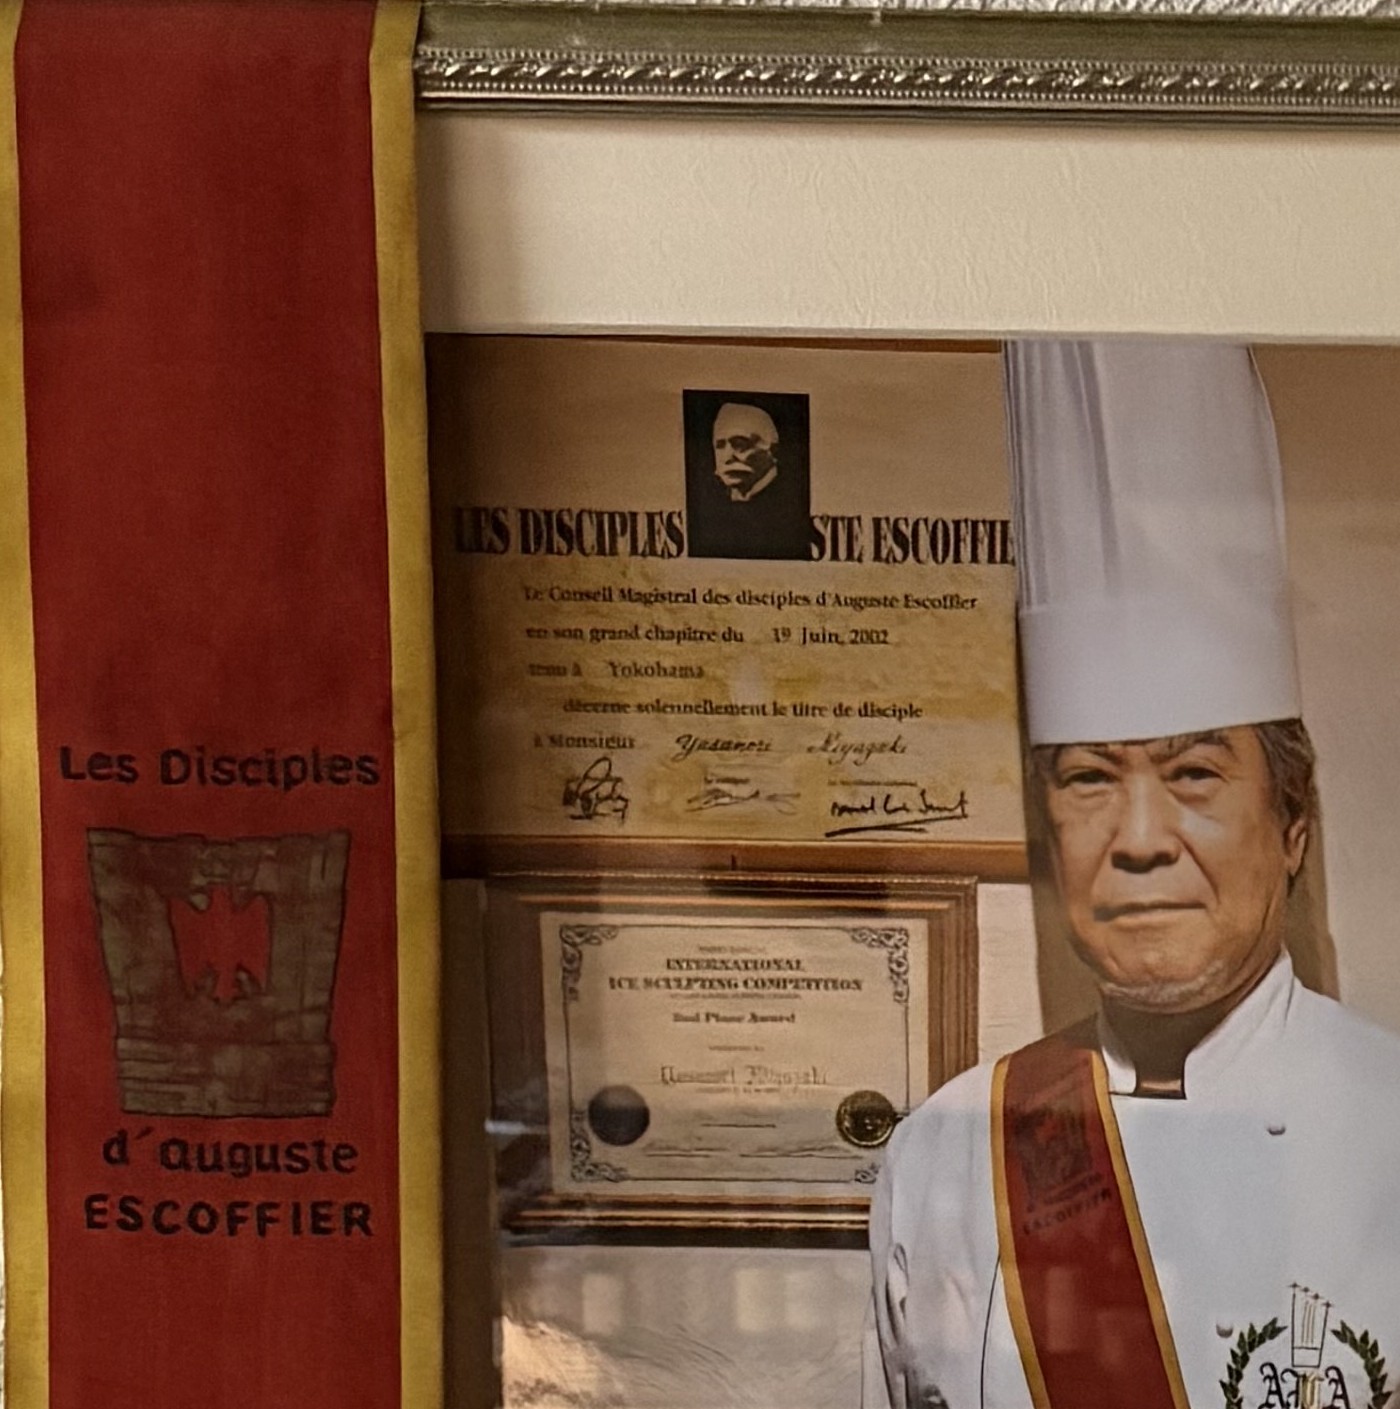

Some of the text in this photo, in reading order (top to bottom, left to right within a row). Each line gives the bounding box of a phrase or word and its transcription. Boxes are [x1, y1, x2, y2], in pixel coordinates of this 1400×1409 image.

[453, 506, 511, 556] LES
[518, 507, 685, 560] DISCIPLES
[549, 586, 613, 603] Conseil
[618, 587, 697, 606] Magistral
[702, 588, 731, 605] des
[736, 590, 811, 610] disciples
[903, 593, 978, 611] Escoffier
[526, 627, 548, 640] en
[553, 627, 584, 640] son
[589, 624, 640, 645] grand
[645, 625, 717, 645] chapitre
[721, 626, 744, 643] du
[849, 628, 890, 645] 2002
[609, 660, 705, 679] Yokohama
[773, 701, 789, 717] le
[793, 701, 829, 718] titre
[832, 702, 853, 718] de
[858, 702, 924, 722] disciple
[59, 744, 382, 792] Les Disciples
[665, 958, 805, 972] INTERNATIONAL
[743, 976, 864, 992] COMPETITION
[84, 1192, 375, 1238] ESCOFFIER
